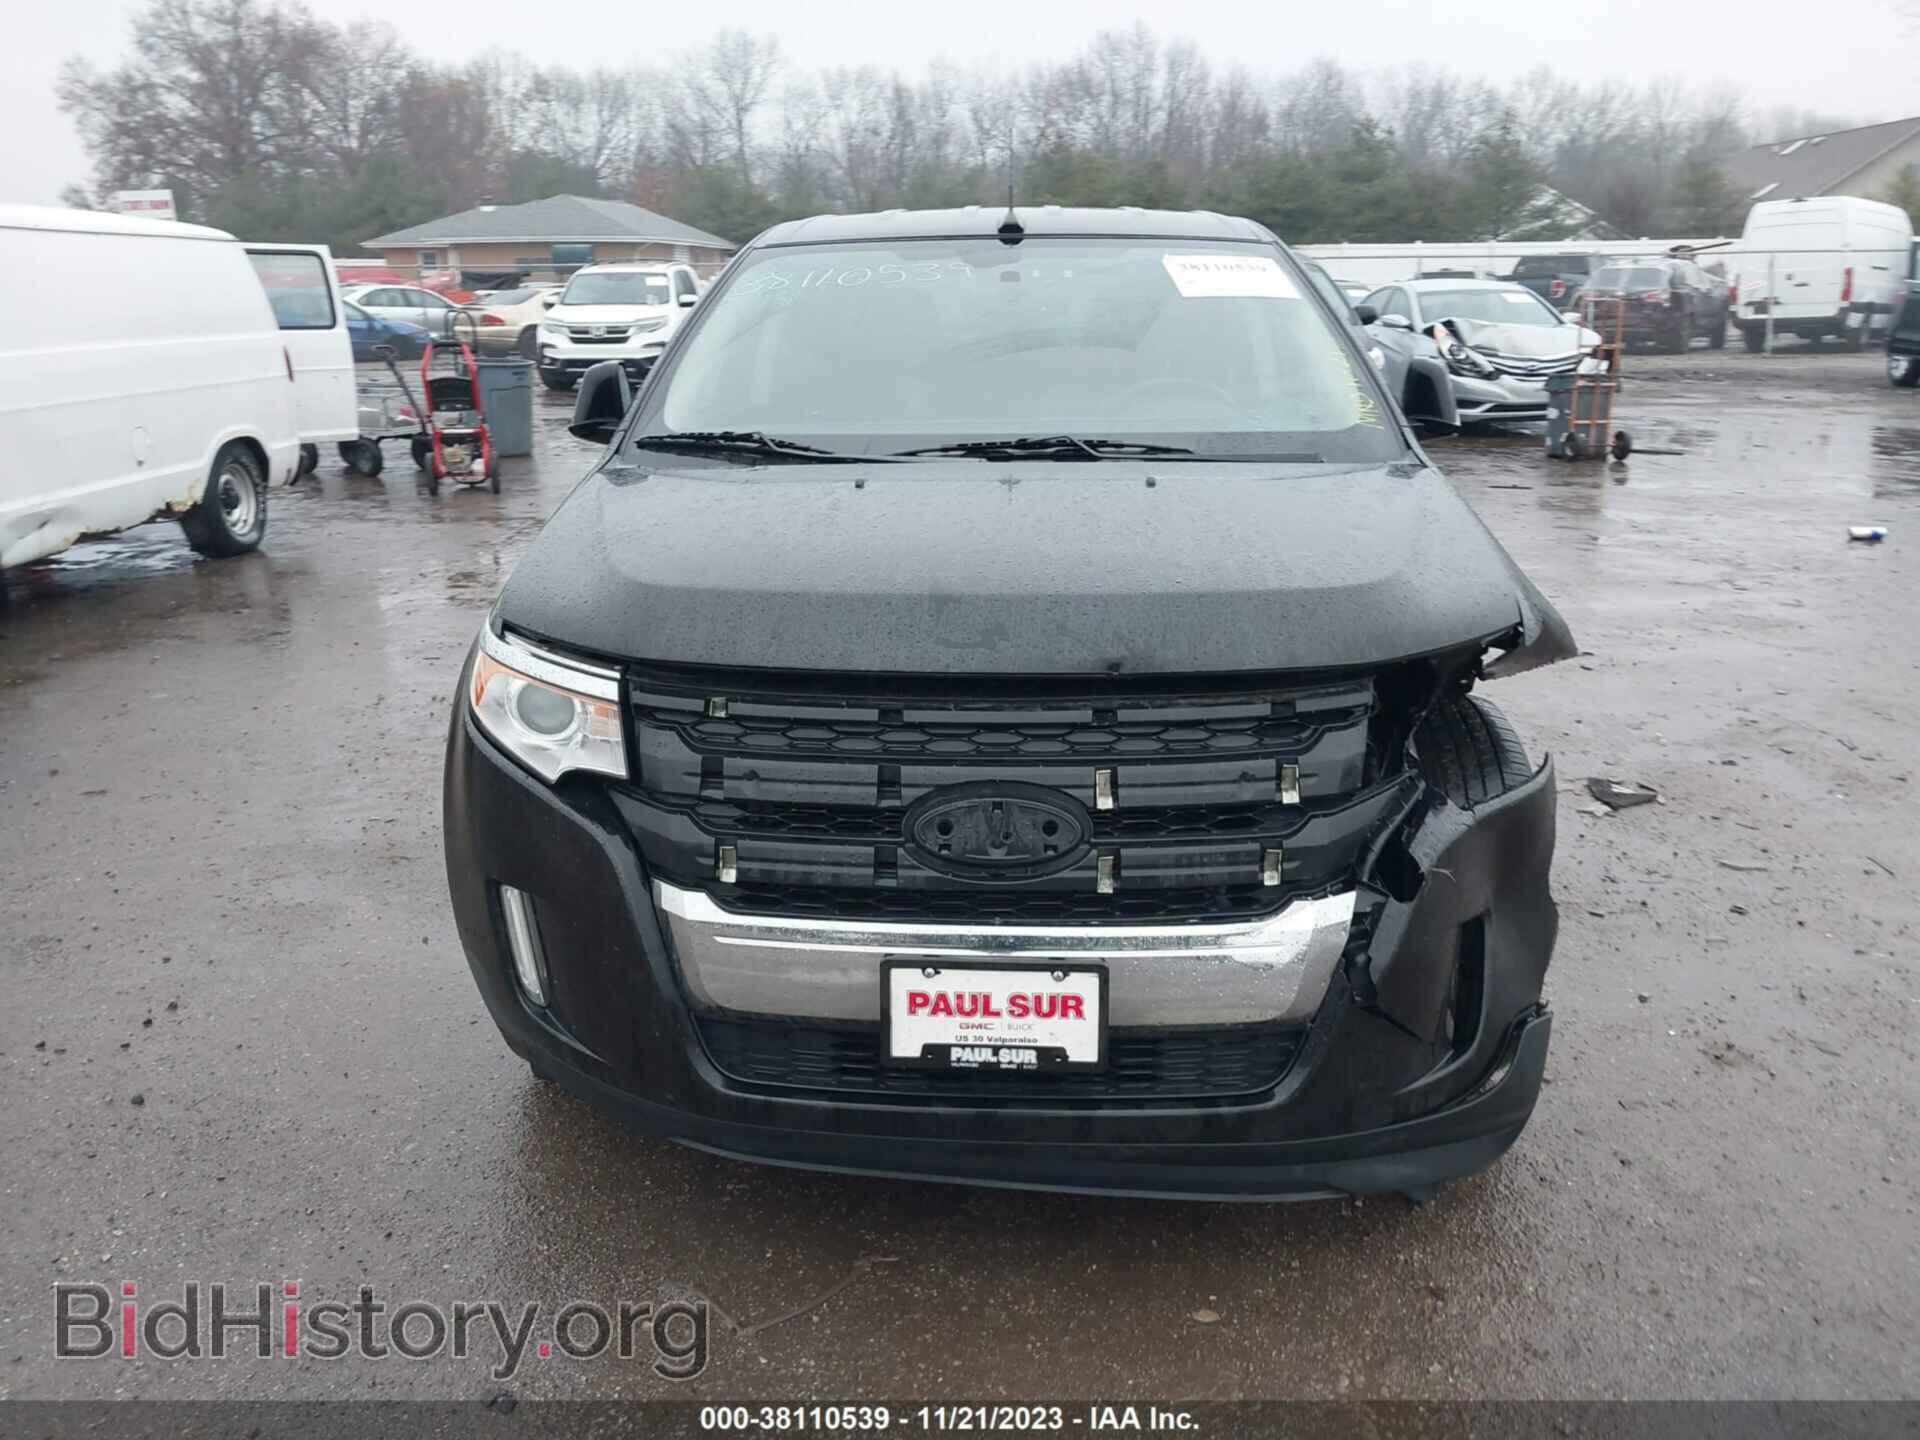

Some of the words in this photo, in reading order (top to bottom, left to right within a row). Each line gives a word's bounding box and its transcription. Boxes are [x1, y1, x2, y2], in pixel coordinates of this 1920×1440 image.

[907, 991, 1002, 1018] PAUL
[1007, 993, 1086, 1020] SUR
[959, 1022, 995, 1030] GMC
[950, 1047, 998, 1063] PAUL
[999, 1048, 1038, 1064] SUR
